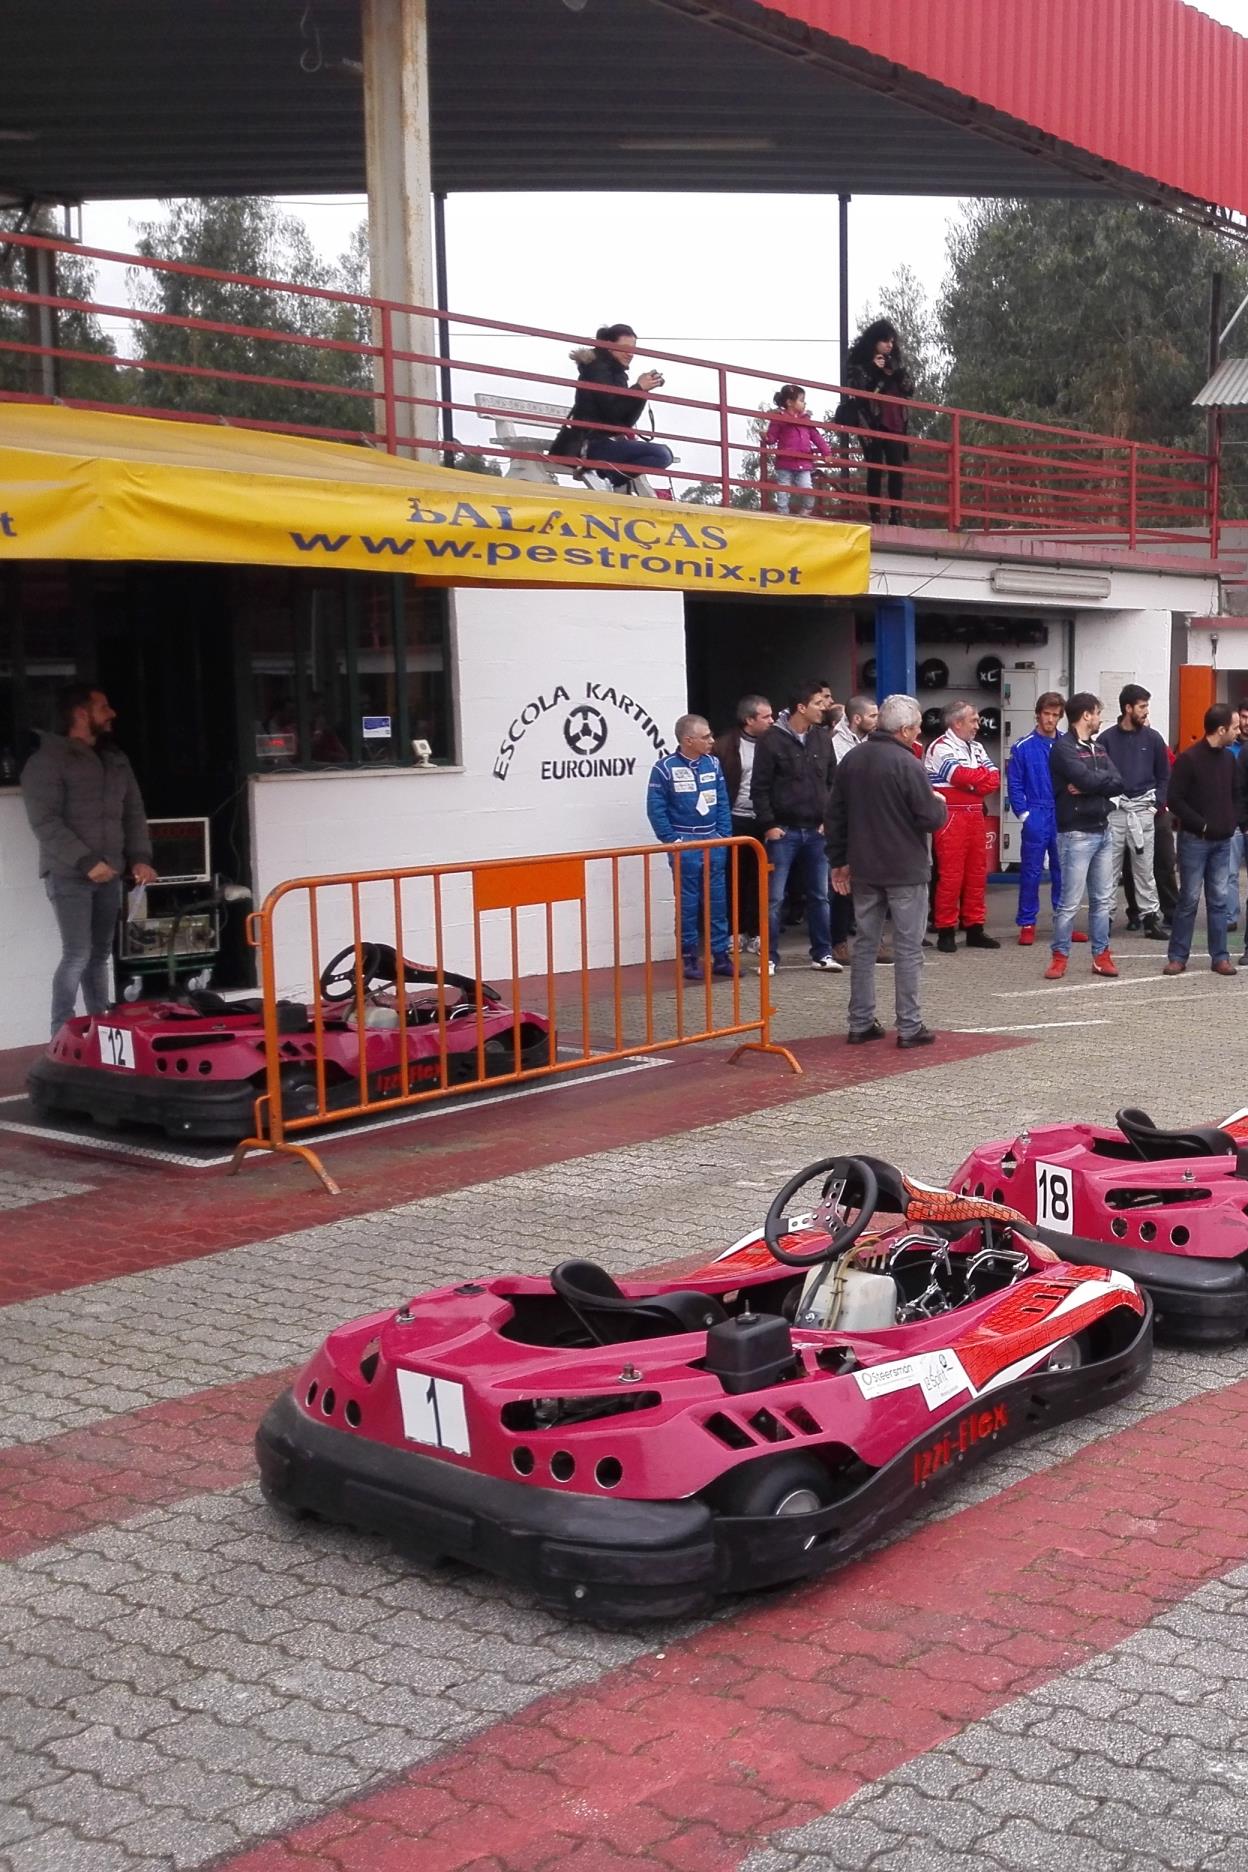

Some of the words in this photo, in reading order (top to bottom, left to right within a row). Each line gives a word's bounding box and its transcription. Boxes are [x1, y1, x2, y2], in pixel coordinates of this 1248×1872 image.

[289, 532, 804, 587] www.pestronix.pt
[492, 685, 570, 781] ESCOLA
[541, 758, 637, 780] EUROINDY
[108, 1027, 126, 1066] 12
[1039, 1169, 1069, 1221] 18
[426, 1377, 443, 1446] 1
